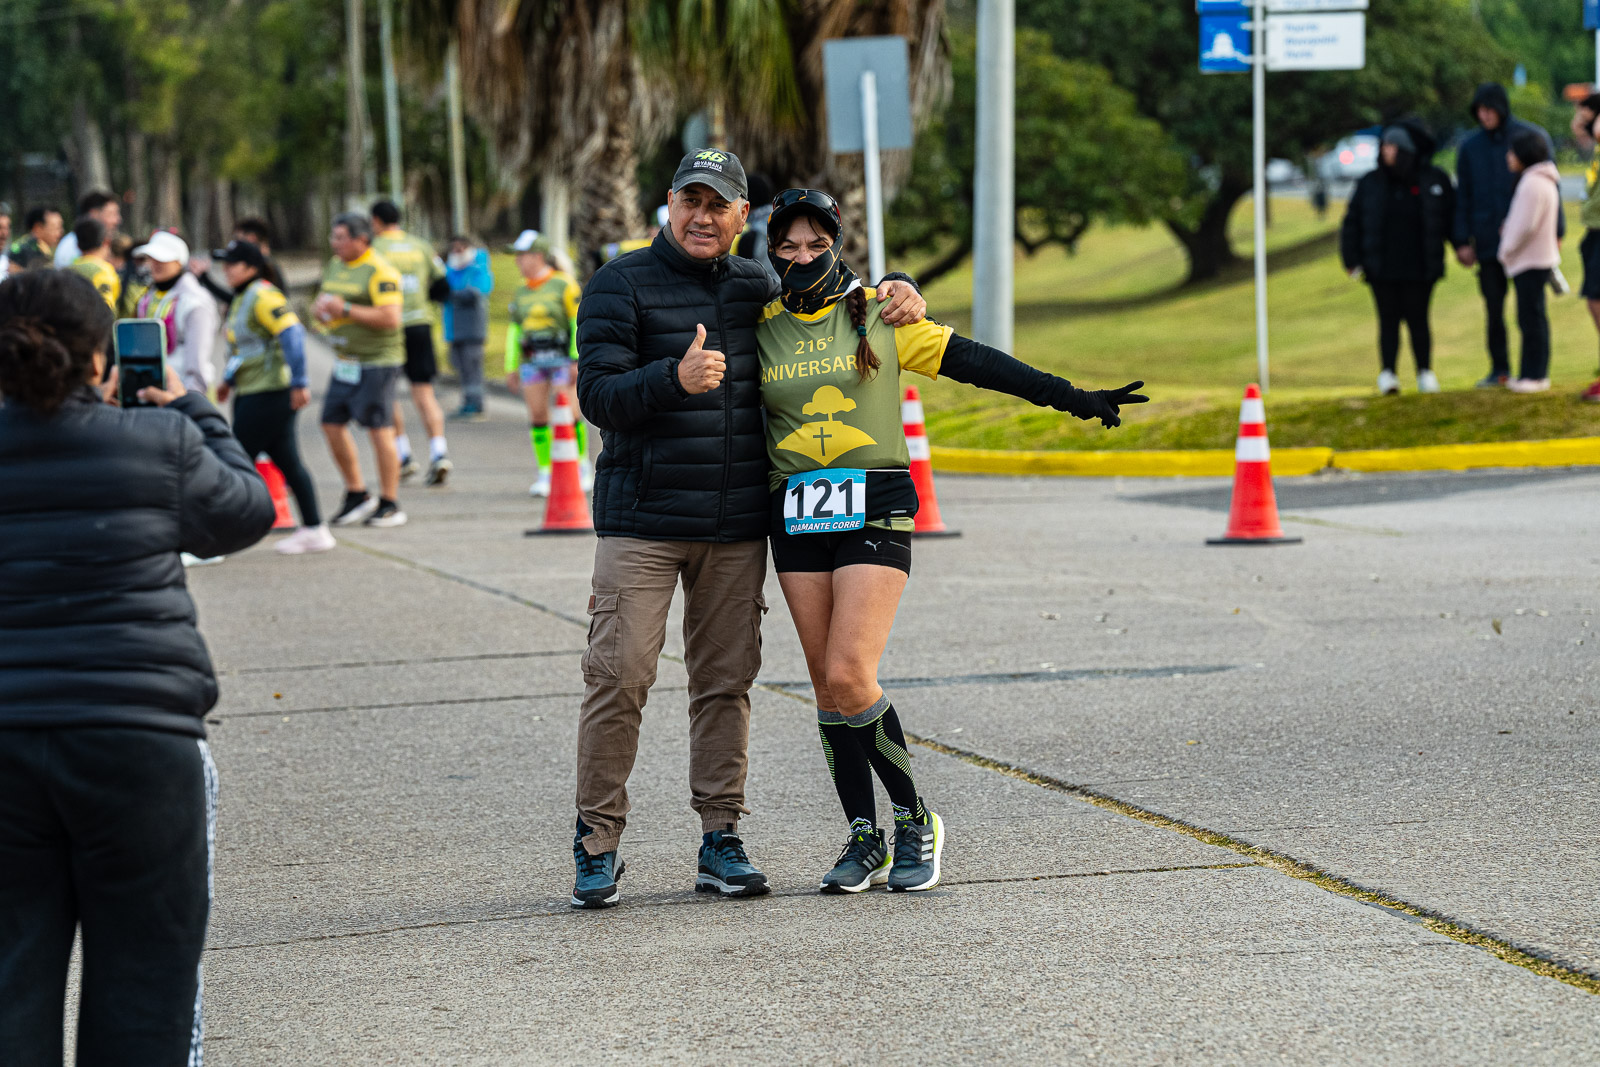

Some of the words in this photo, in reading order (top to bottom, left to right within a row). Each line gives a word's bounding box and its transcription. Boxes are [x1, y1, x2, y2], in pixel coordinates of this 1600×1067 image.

[695, 151, 727, 163] 46
[700, 160, 722, 170] YAMAHA
[761, 354, 871, 384] ANIVERSAR
[791, 478, 853, 520] 121
[790, 521, 831, 533] DIAMANTE
[832, 520, 861, 530] CORRE
[851, 825, 872, 833] LACK
